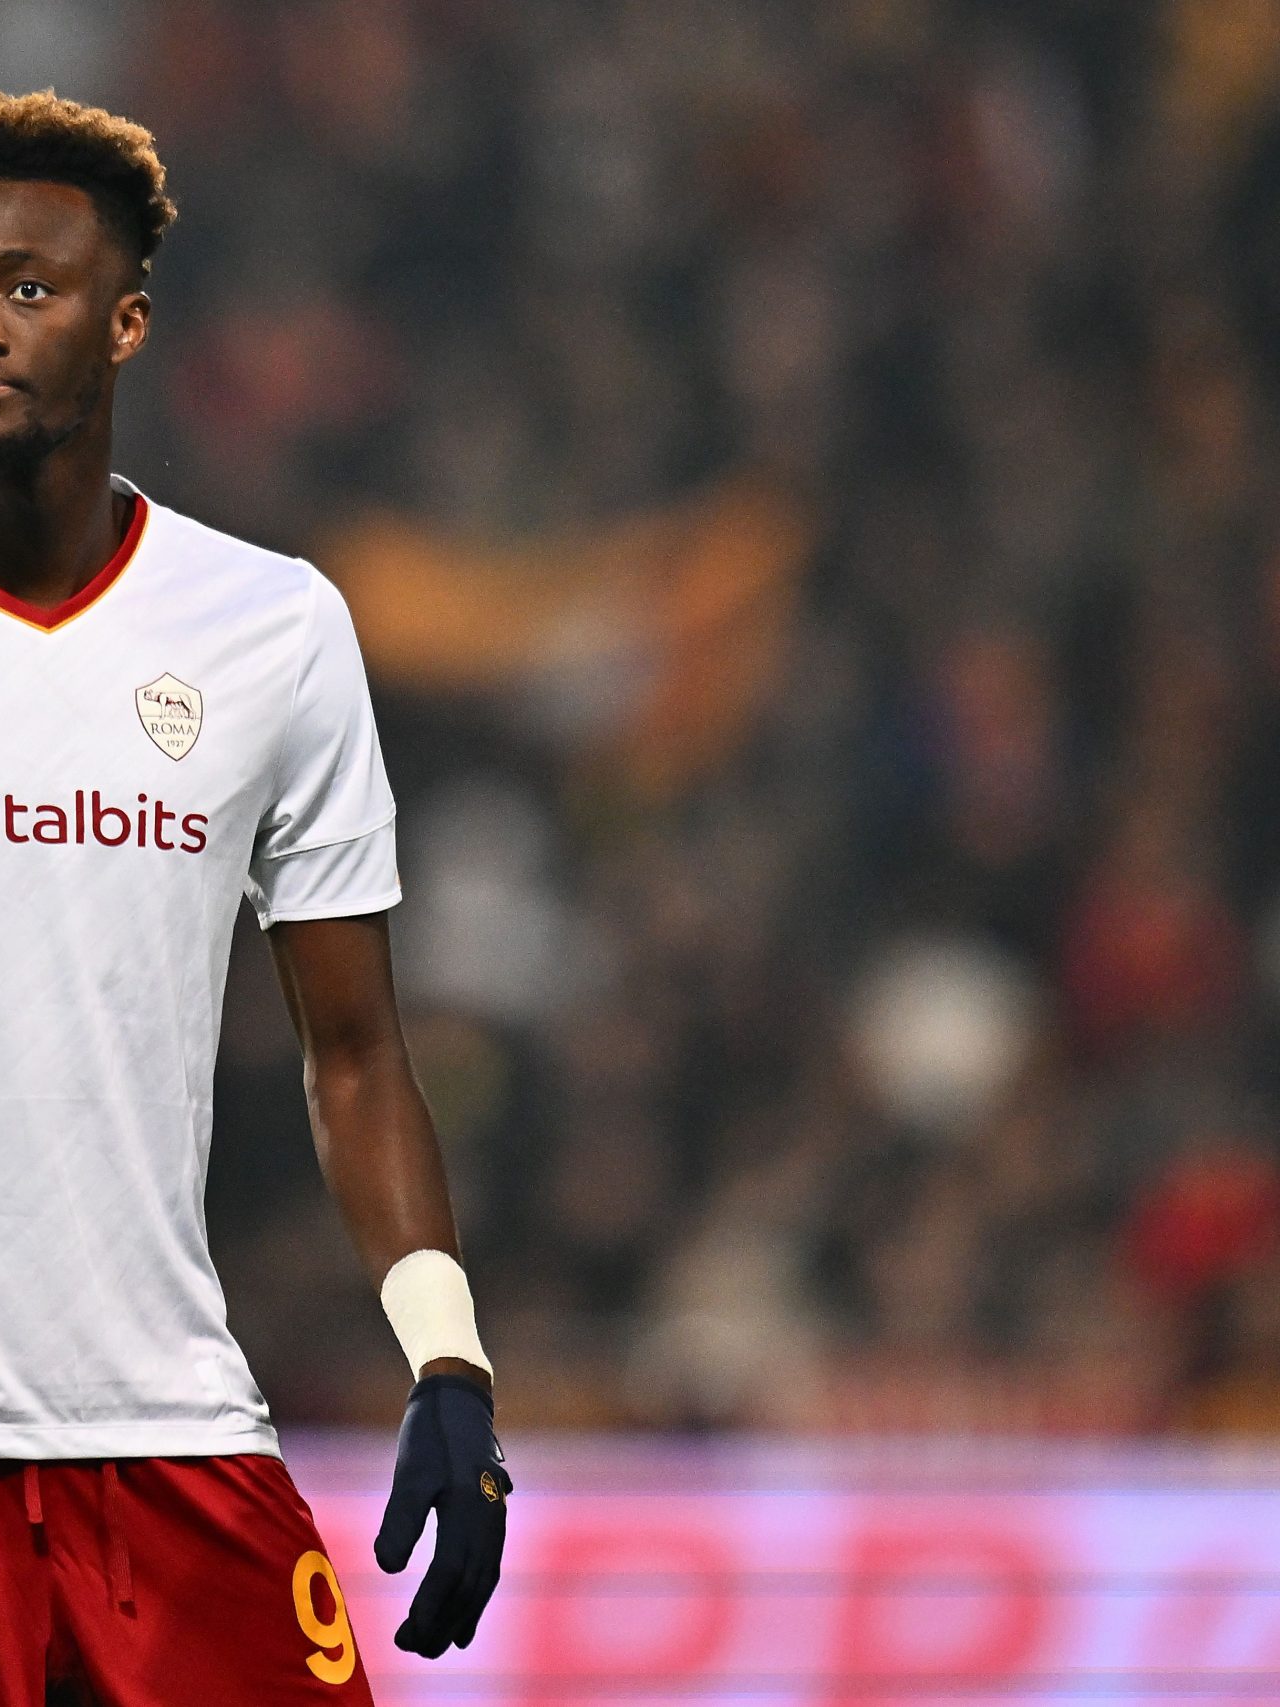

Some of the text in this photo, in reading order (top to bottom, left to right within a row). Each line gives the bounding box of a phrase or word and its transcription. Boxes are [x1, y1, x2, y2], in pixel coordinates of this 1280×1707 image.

[150, 722, 196, 737] ROMA
[166, 740, 185, 749] 1927
[292, 1550, 356, 1685] 9
